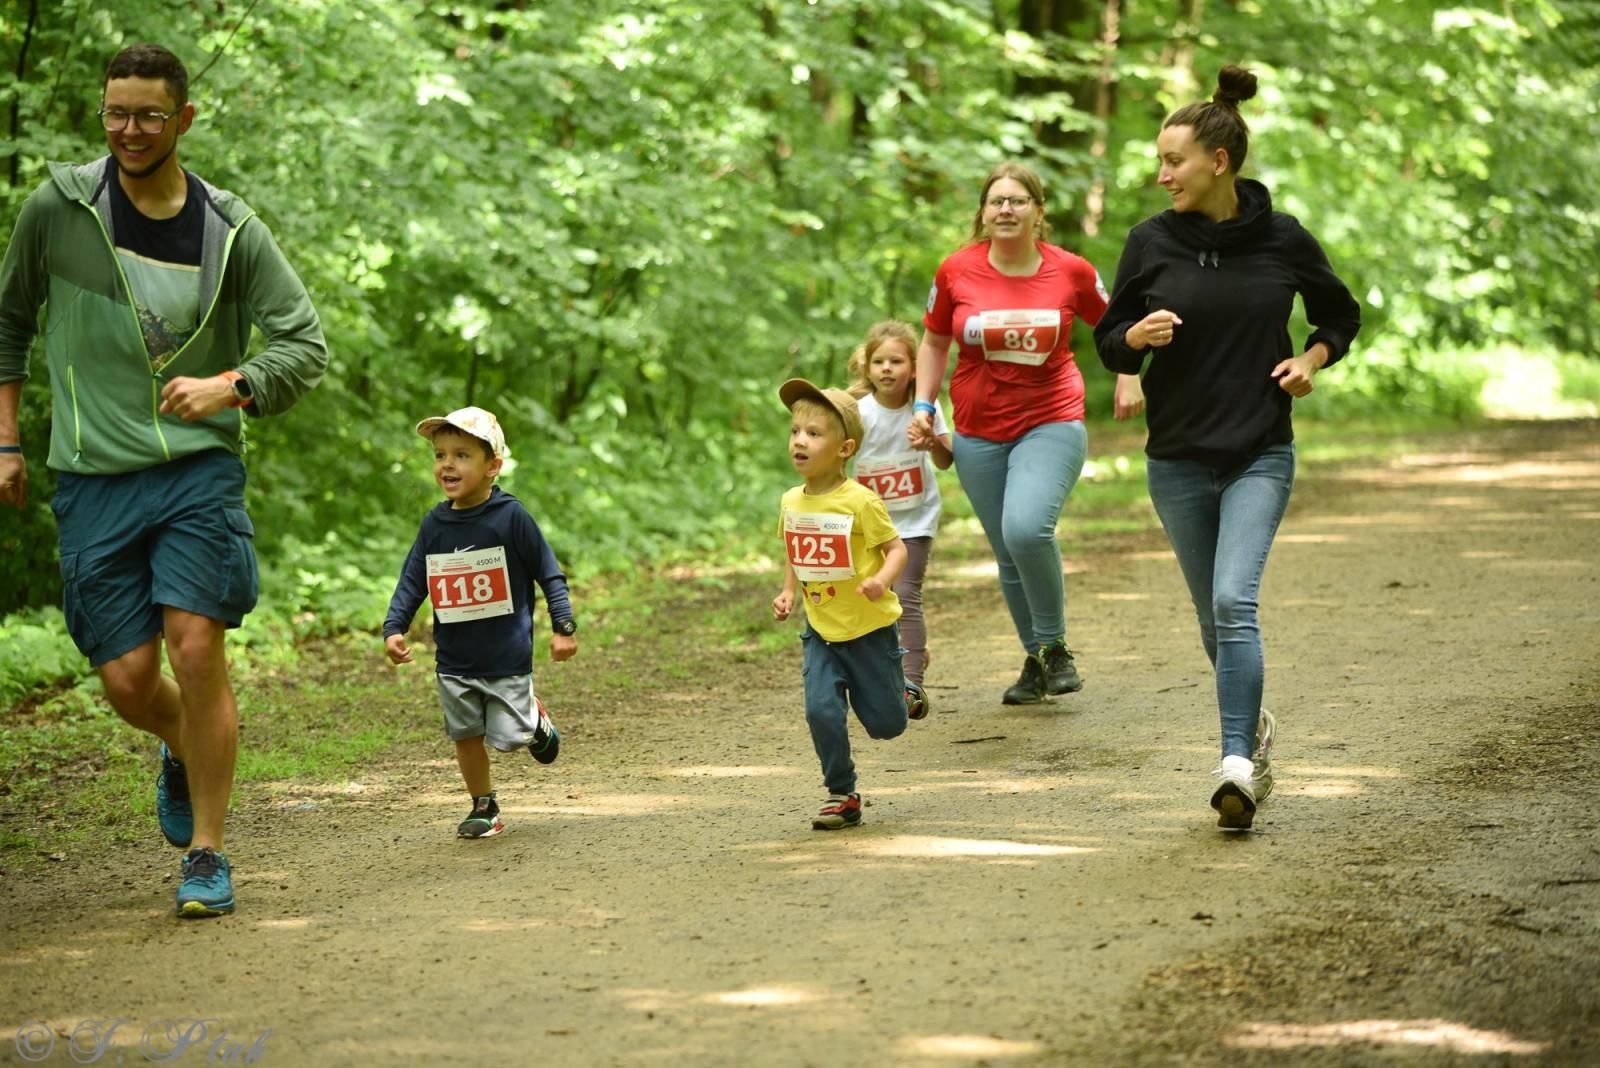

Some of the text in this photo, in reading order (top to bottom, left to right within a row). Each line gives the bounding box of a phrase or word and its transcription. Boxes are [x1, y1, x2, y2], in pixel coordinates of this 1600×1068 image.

[1004, 328, 1037, 352] 86
[867, 472, 914, 498] 124
[823, 522, 840, 530] 4500
[476, 558, 494, 566] 4500
[791, 535, 836, 565] 125
[436, 573, 493, 606] 118
